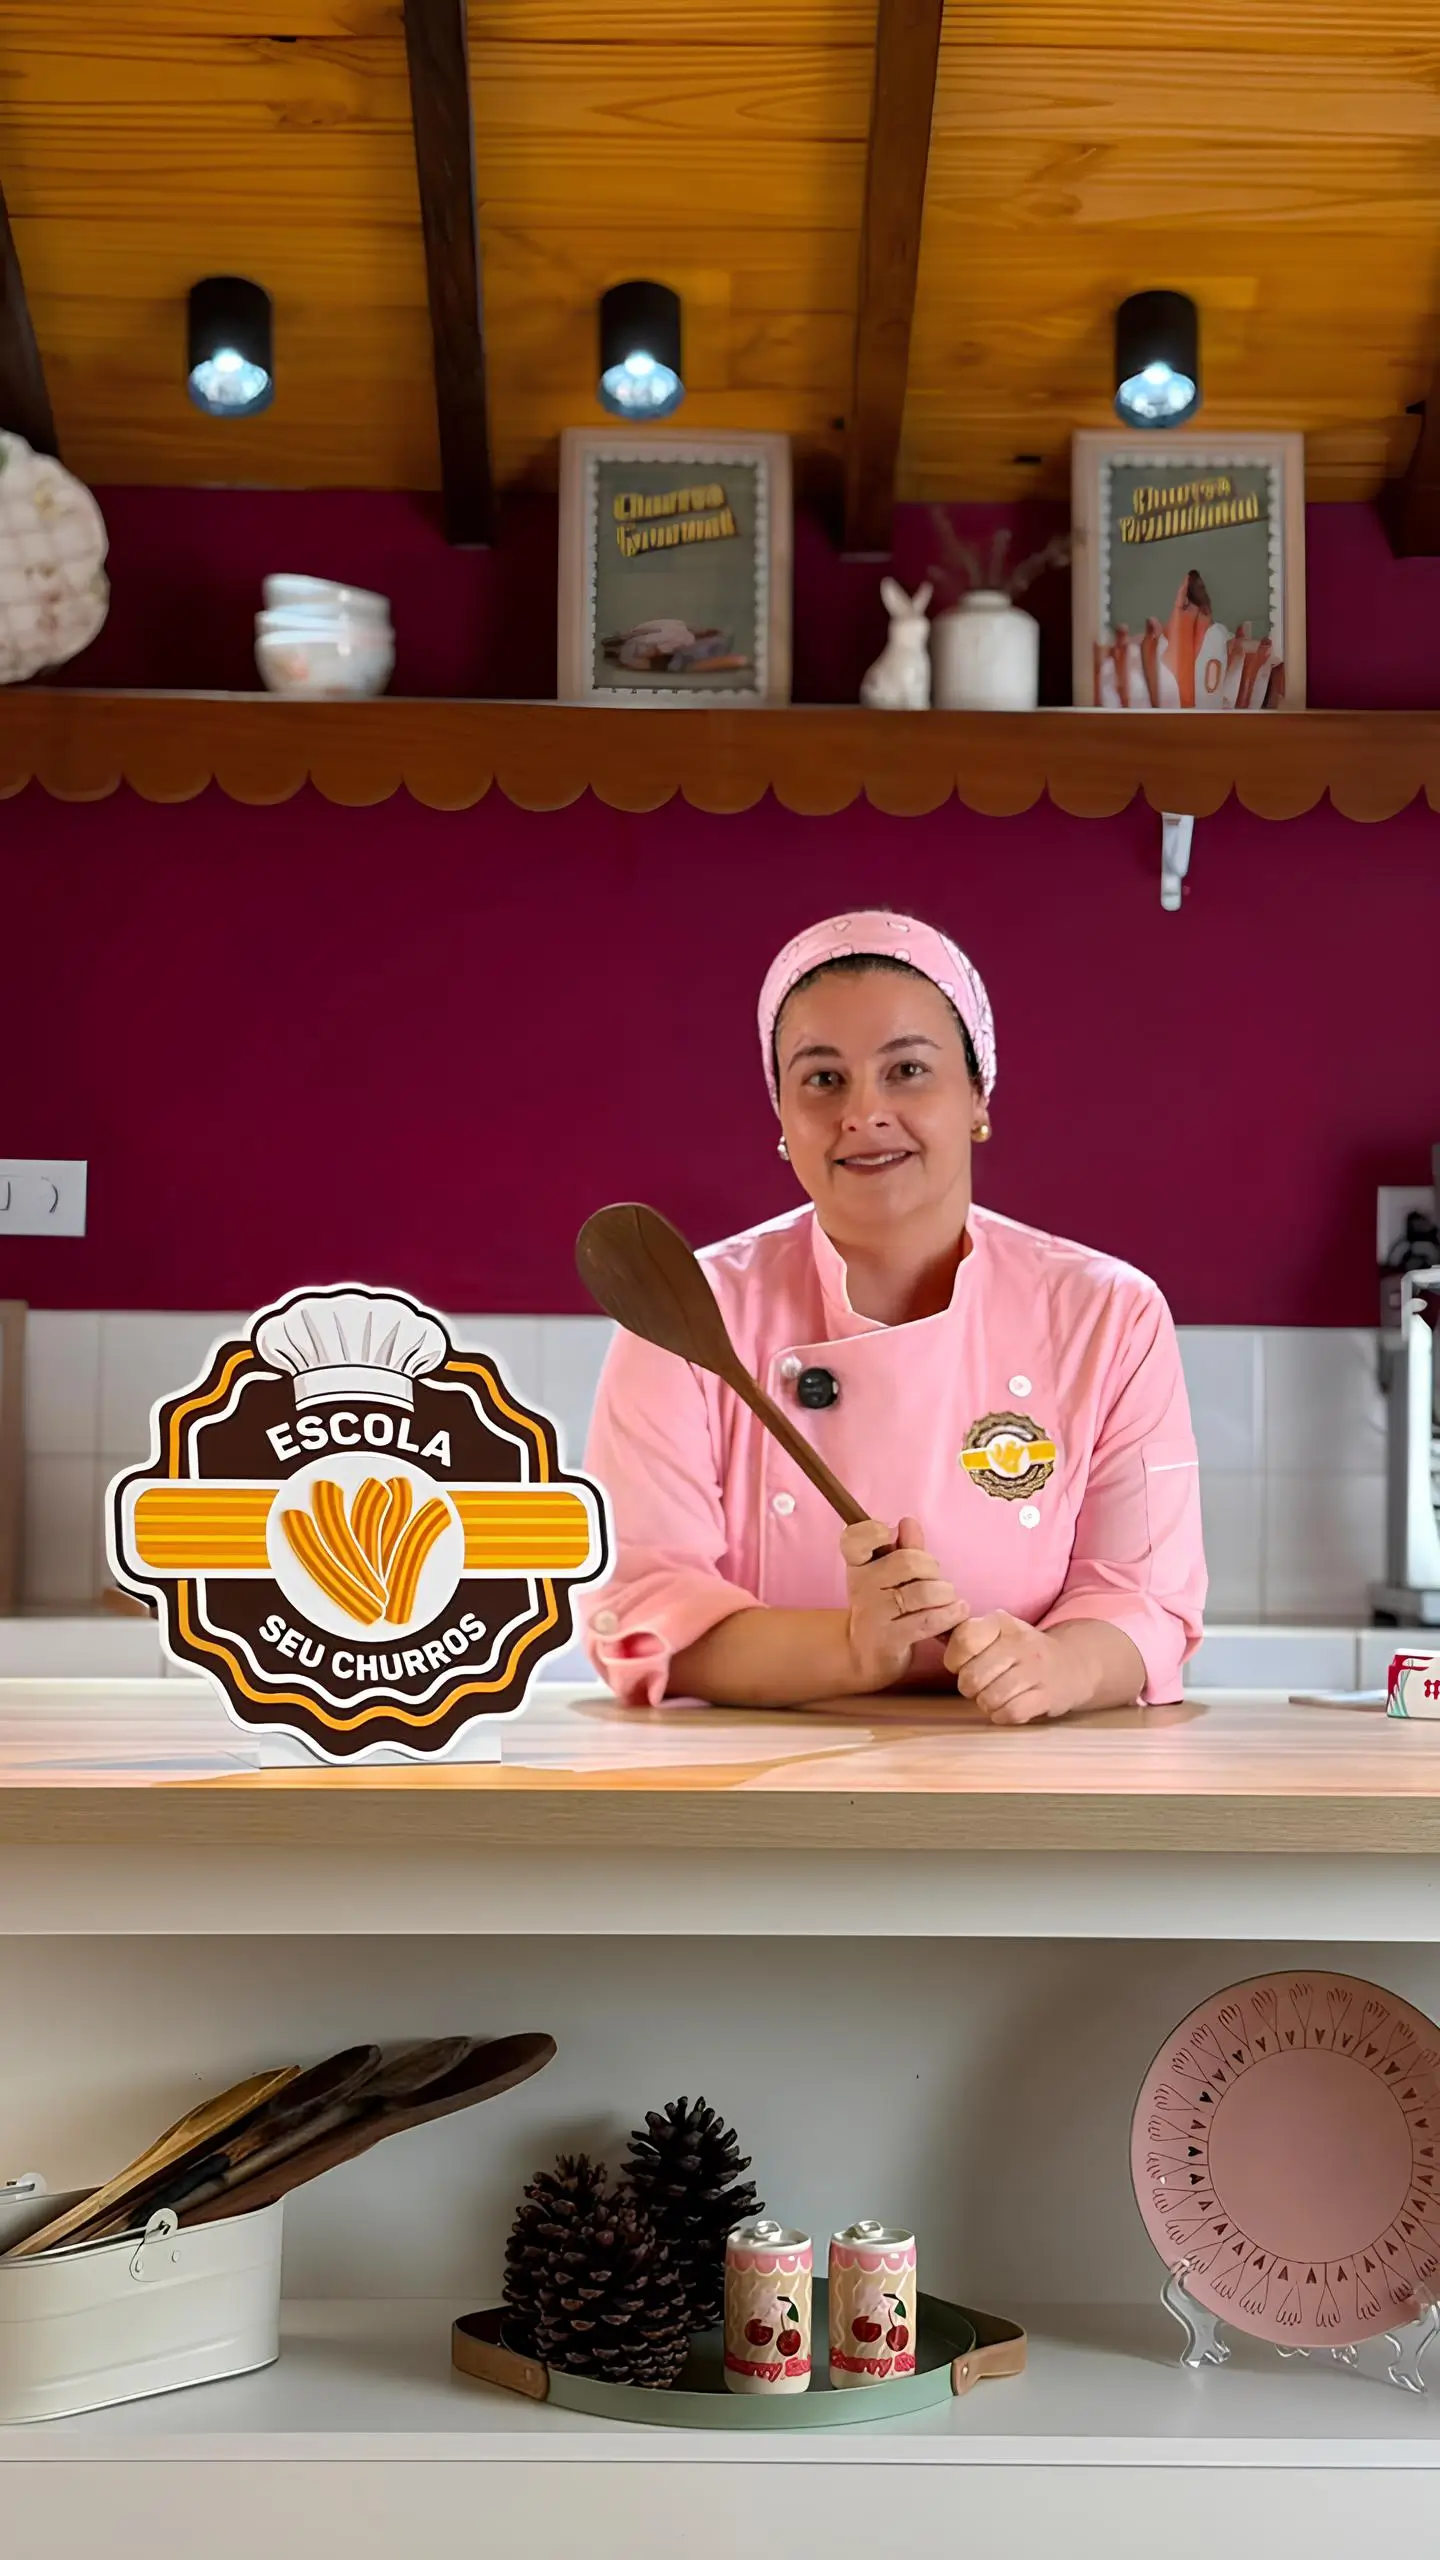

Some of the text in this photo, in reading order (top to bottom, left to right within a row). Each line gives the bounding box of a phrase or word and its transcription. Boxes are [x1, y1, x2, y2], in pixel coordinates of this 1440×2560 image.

[266, 1412, 451, 1467] ESCOLA
[258, 1612, 487, 1681] SEU CHURROS
